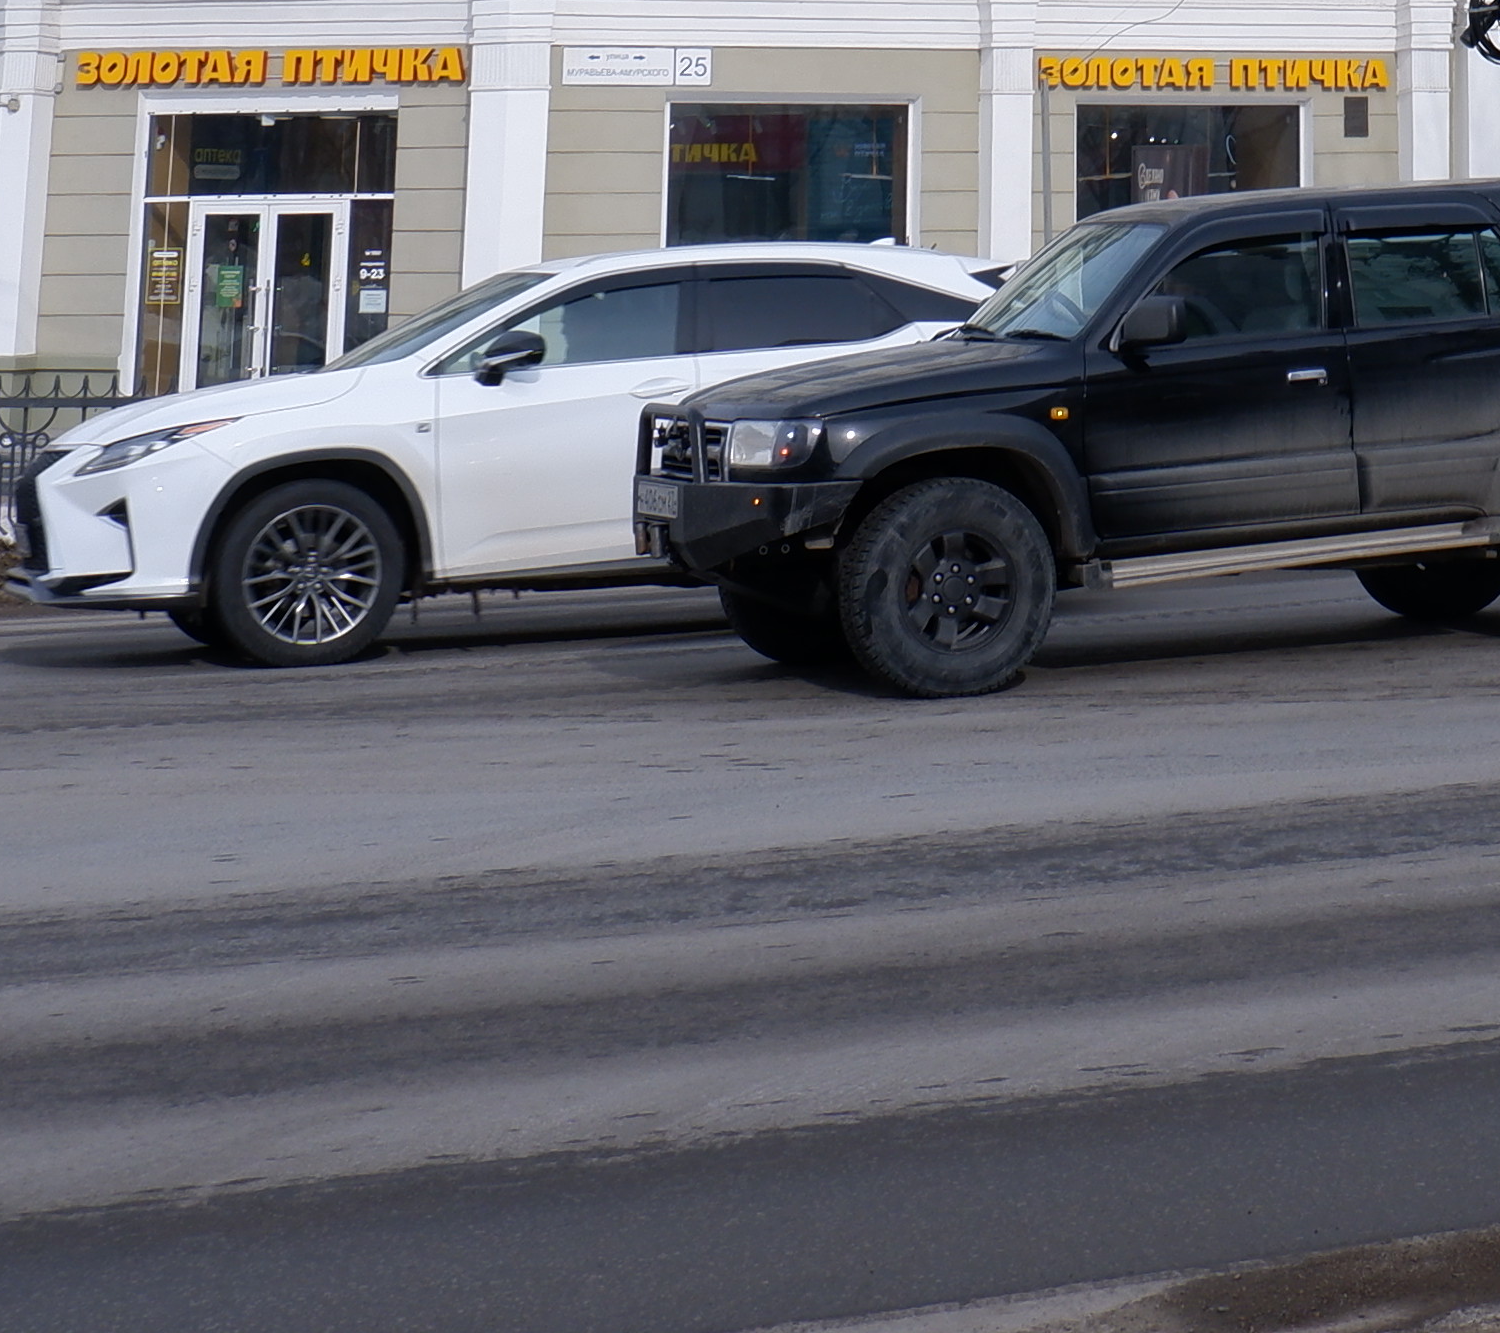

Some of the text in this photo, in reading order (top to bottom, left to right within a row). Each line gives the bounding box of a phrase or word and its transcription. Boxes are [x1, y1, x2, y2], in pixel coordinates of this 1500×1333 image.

[605, 53, 630, 61] улица
[75, 47, 466, 86] ЗОЛОТАЯ ПТИЧКА
[566, 68, 669, 77] МУРАВЬЕВА-АМУРСКОГО
[679, 56, 708, 77] 25
[1038, 56, 1391, 89] ЗОЛОТАЯ ПТИЧКА
[194, 148, 243, 164] аптека
[671, 142, 759, 163] ТИЧКА
[359, 268, 386, 281] 9-23
